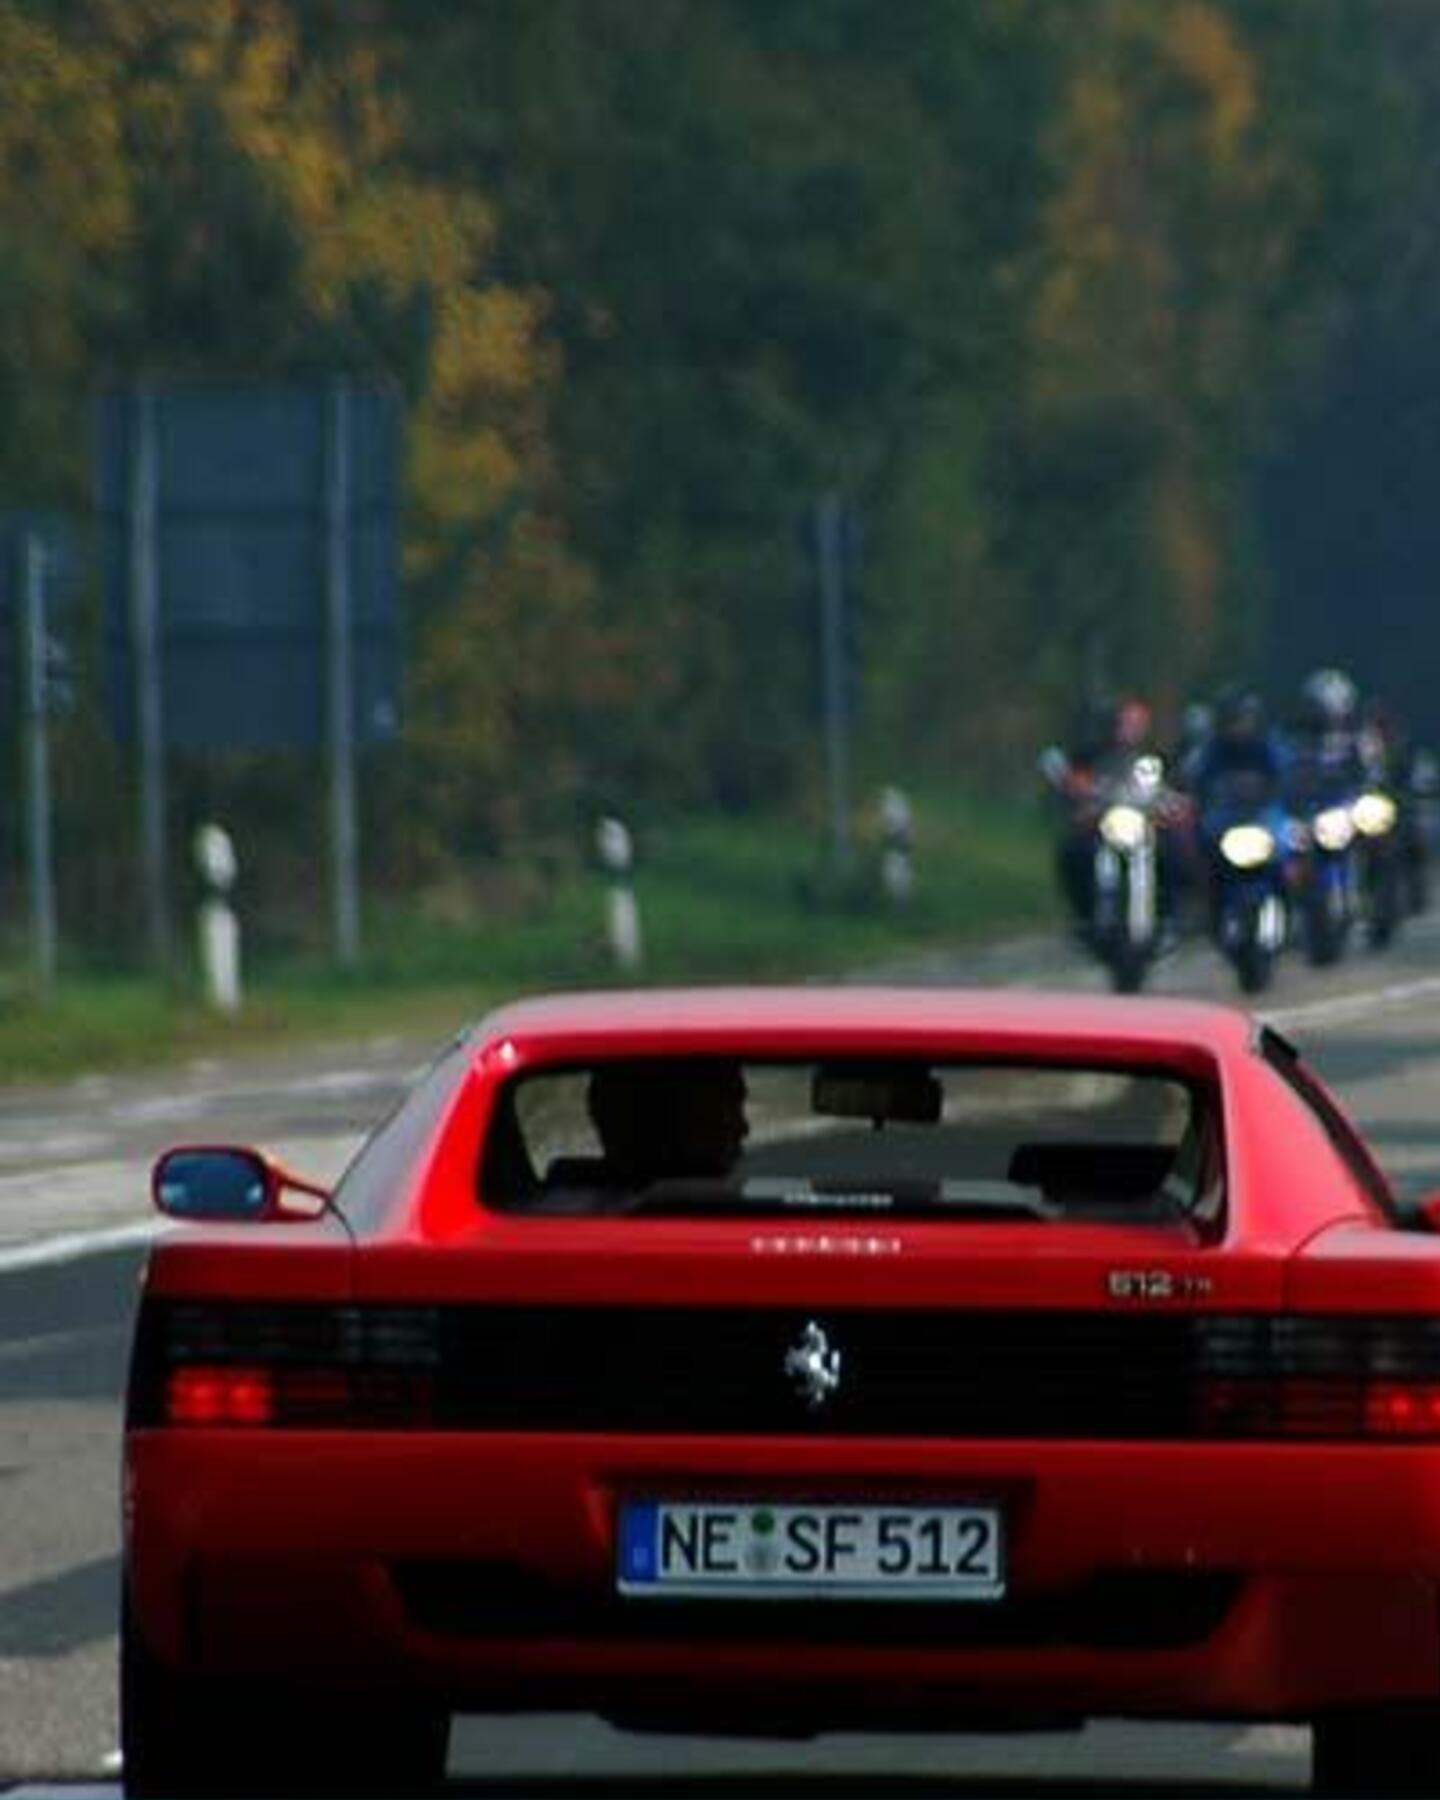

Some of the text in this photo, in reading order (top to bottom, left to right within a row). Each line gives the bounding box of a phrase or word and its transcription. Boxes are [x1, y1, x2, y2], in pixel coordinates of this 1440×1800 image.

[662, 1514, 990, 1575] NE SF 512
